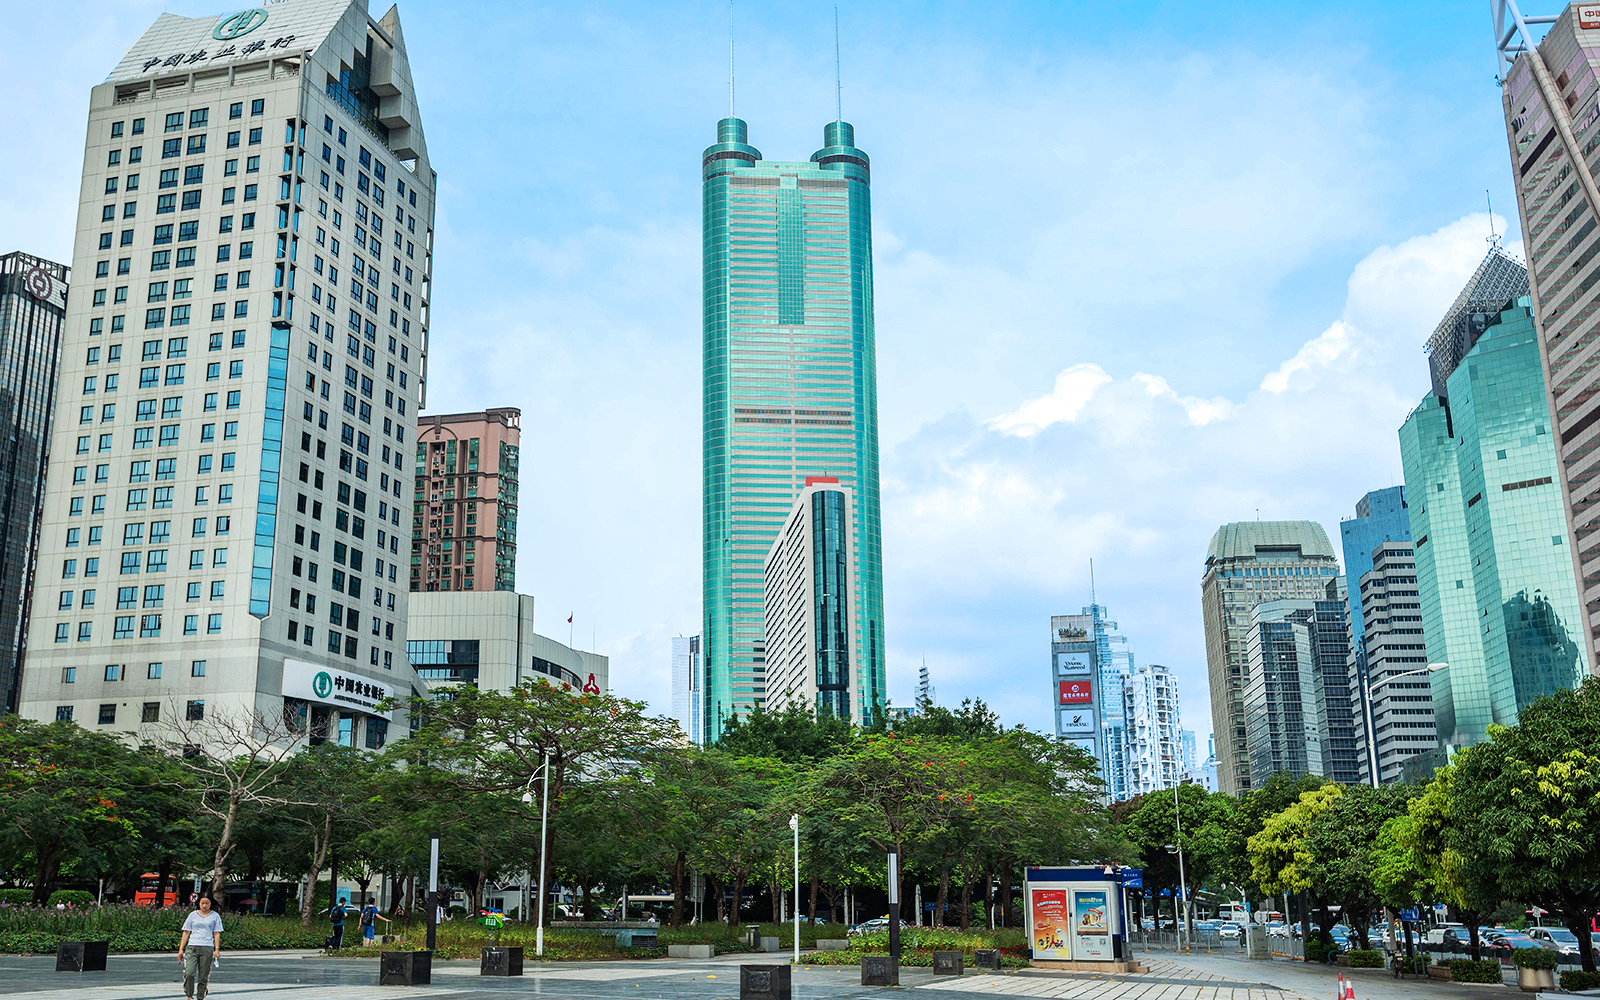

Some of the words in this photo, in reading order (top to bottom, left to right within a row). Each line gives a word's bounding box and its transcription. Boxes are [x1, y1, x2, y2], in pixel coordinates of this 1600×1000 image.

[143, 35, 295, 72] 中国农业银行
[334, 675, 385, 701] 中国农业银行
